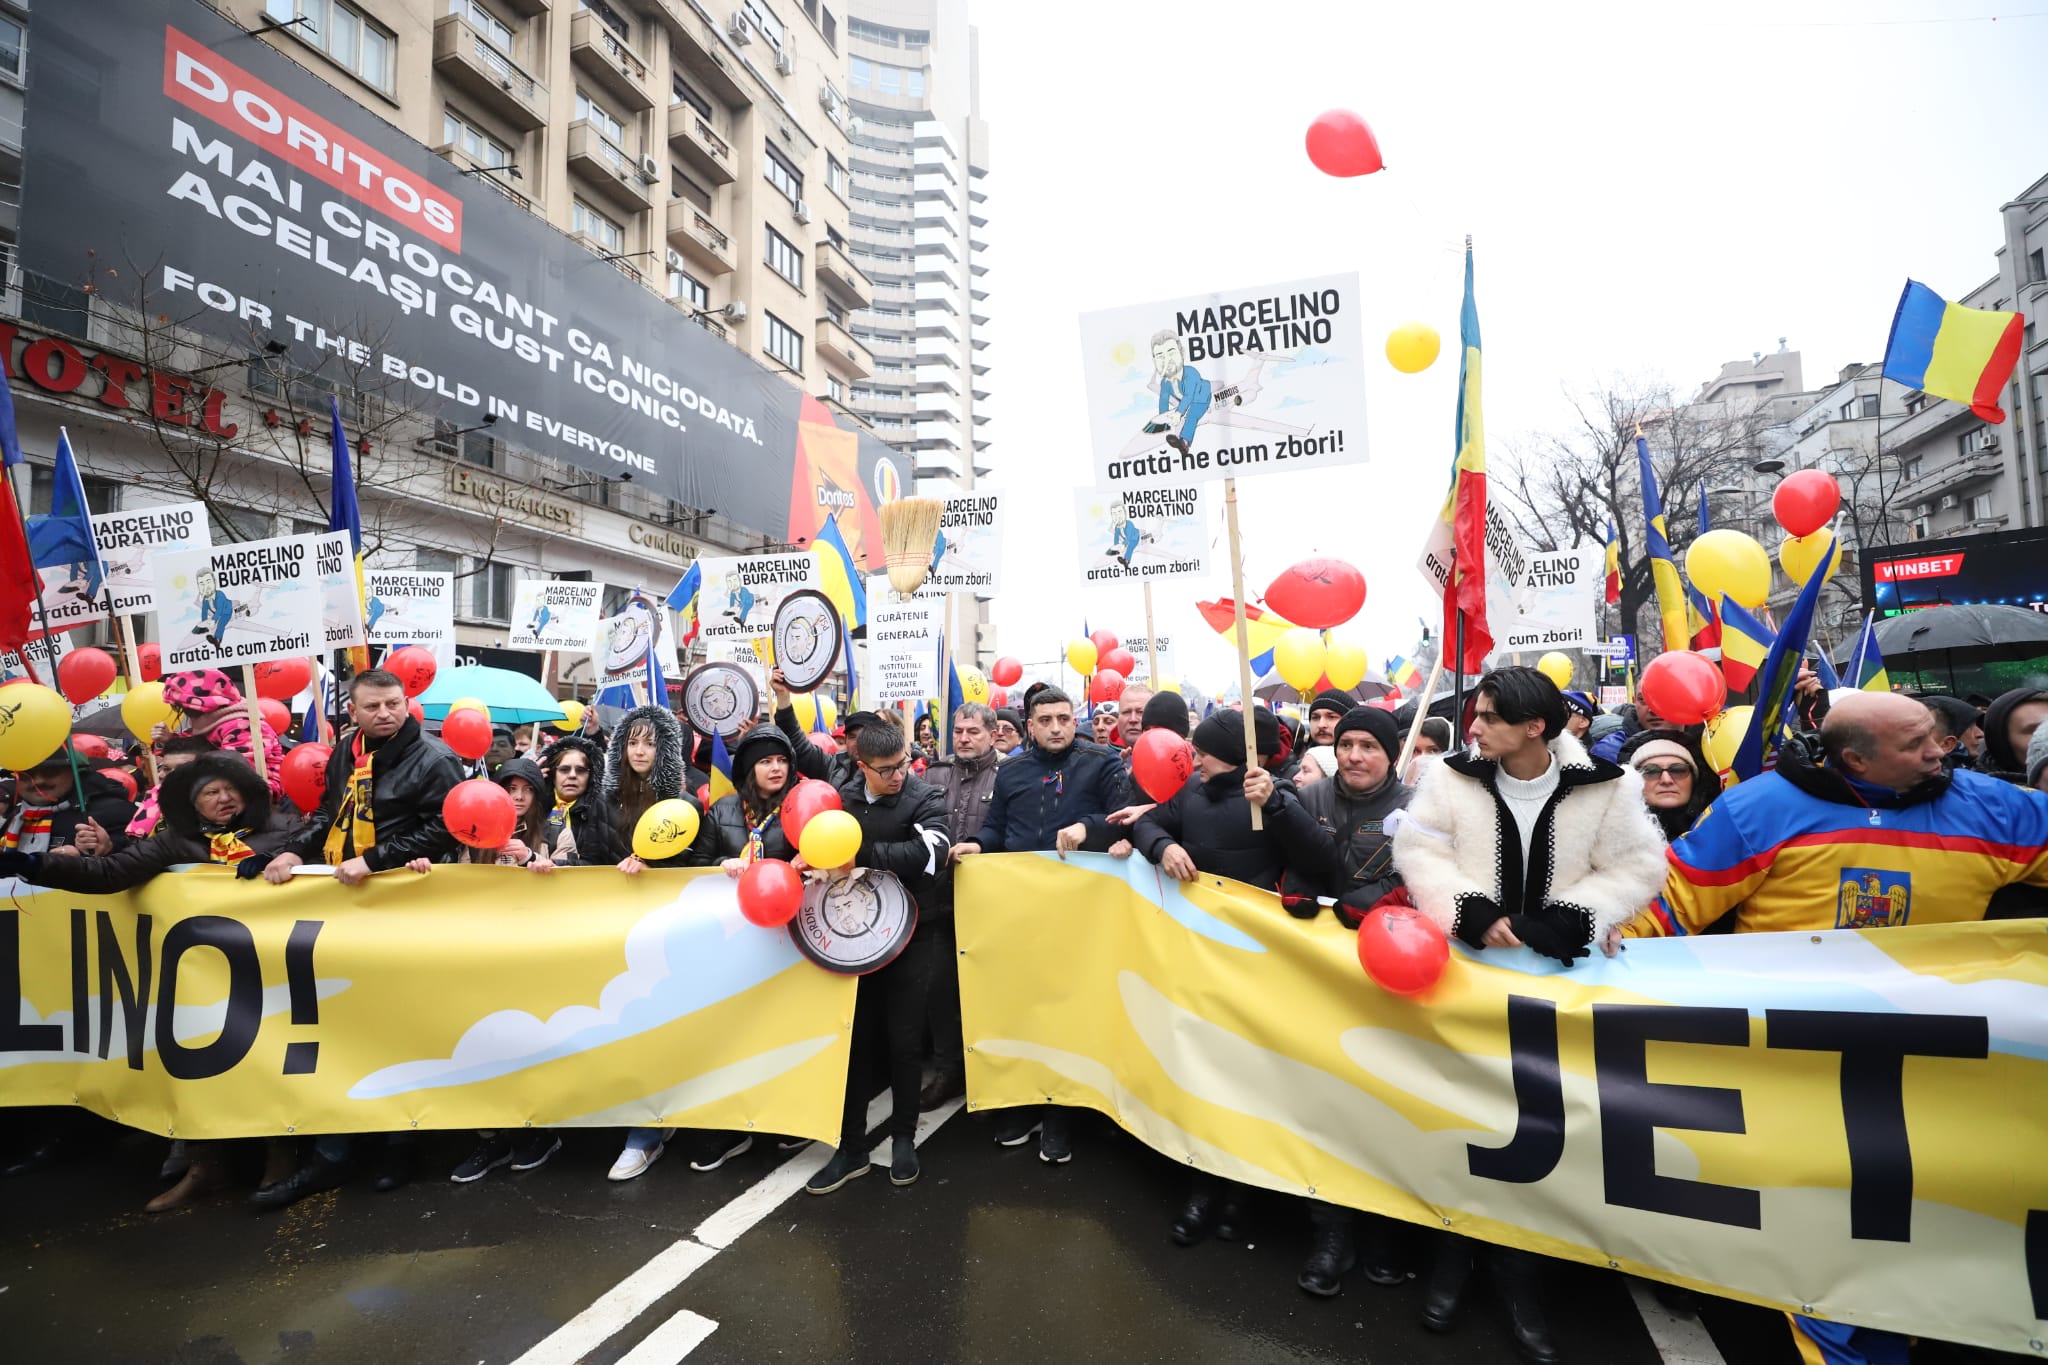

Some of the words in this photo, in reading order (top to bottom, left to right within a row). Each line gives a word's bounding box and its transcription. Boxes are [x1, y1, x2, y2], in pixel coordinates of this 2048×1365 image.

[175, 50, 455, 234] DORITOS
[172, 117, 303, 213] MAI
[321, 201, 558, 337] CROCANT
[567, 328, 614, 370] CA
[622, 356, 764, 446] NICIODATĂ.
[166, 171, 437, 317] ACELAȘI
[450, 304, 565, 373] GUST
[573, 360, 687, 432] ICONIC.
[1176, 289, 1340, 337] MARCELINO
[1188, 318, 1332, 362] BURATINO
[163, 265, 272, 330] FOR
[285, 314, 372, 368] THE
[382, 353, 481, 407] BOLD
[488, 395, 518, 423] IN
[526, 410, 658, 475] EVERYONE.
[1108, 449, 1211, 480] arată-ne
[1217, 443, 1269, 468] cum
[1275, 430, 1345, 461] zbori!
[1122, 488, 1198, 505] MARCELINO
[1128, 502, 1195, 519] BURATINO
[1485, 500, 1525, 576] MARCELINO
[211, 543, 305, 572] MARCELINO
[737, 558, 811, 574] MARCELINO
[1529, 556, 1580, 574] ELINO
[218, 562, 301, 588] BURATINO
[1141, 564, 1167, 576] cum
[1169, 559, 1201, 573] zbori!
[1882, 558, 1954, 578] WINBET
[371, 575, 445, 587] MARCELINO
[743, 570, 808, 586] BURATINO
[944, 575, 964, 585] cum
[965, 572, 992, 585] zbori!
[375, 586, 441, 597] BURATINO
[545, 586, 597, 597] MARCELINO
[115, 593, 153, 609] cum
[546, 596, 593, 607] BURATINO
[325, 625, 354, 642] zbori!
[384, 631, 409, 640] cum
[411, 629, 443, 640] zbori!
[877, 627, 929, 641] GENERALĂ
[1125, 637, 1170, 646] MARCINO
[1508, 633, 1538, 646] cum
[1542, 628, 1583, 644] zbori!
[237, 641, 266, 656] cum
[270, 633, 310, 651] zbori!
[545, 638, 563, 646] cum
[564, 637, 587, 648] zbori!
[1128, 644, 1167, 653] BURANO
[890, 654, 913, 662] TOATE
[884, 671, 918, 680] STATULUI
[886, 680, 917, 689] EPURATE
[890, 689, 925, 698] GUNOAIE!
[804, 906, 832, 951] NORDIS
[1467, 993, 1989, 1243] JET
